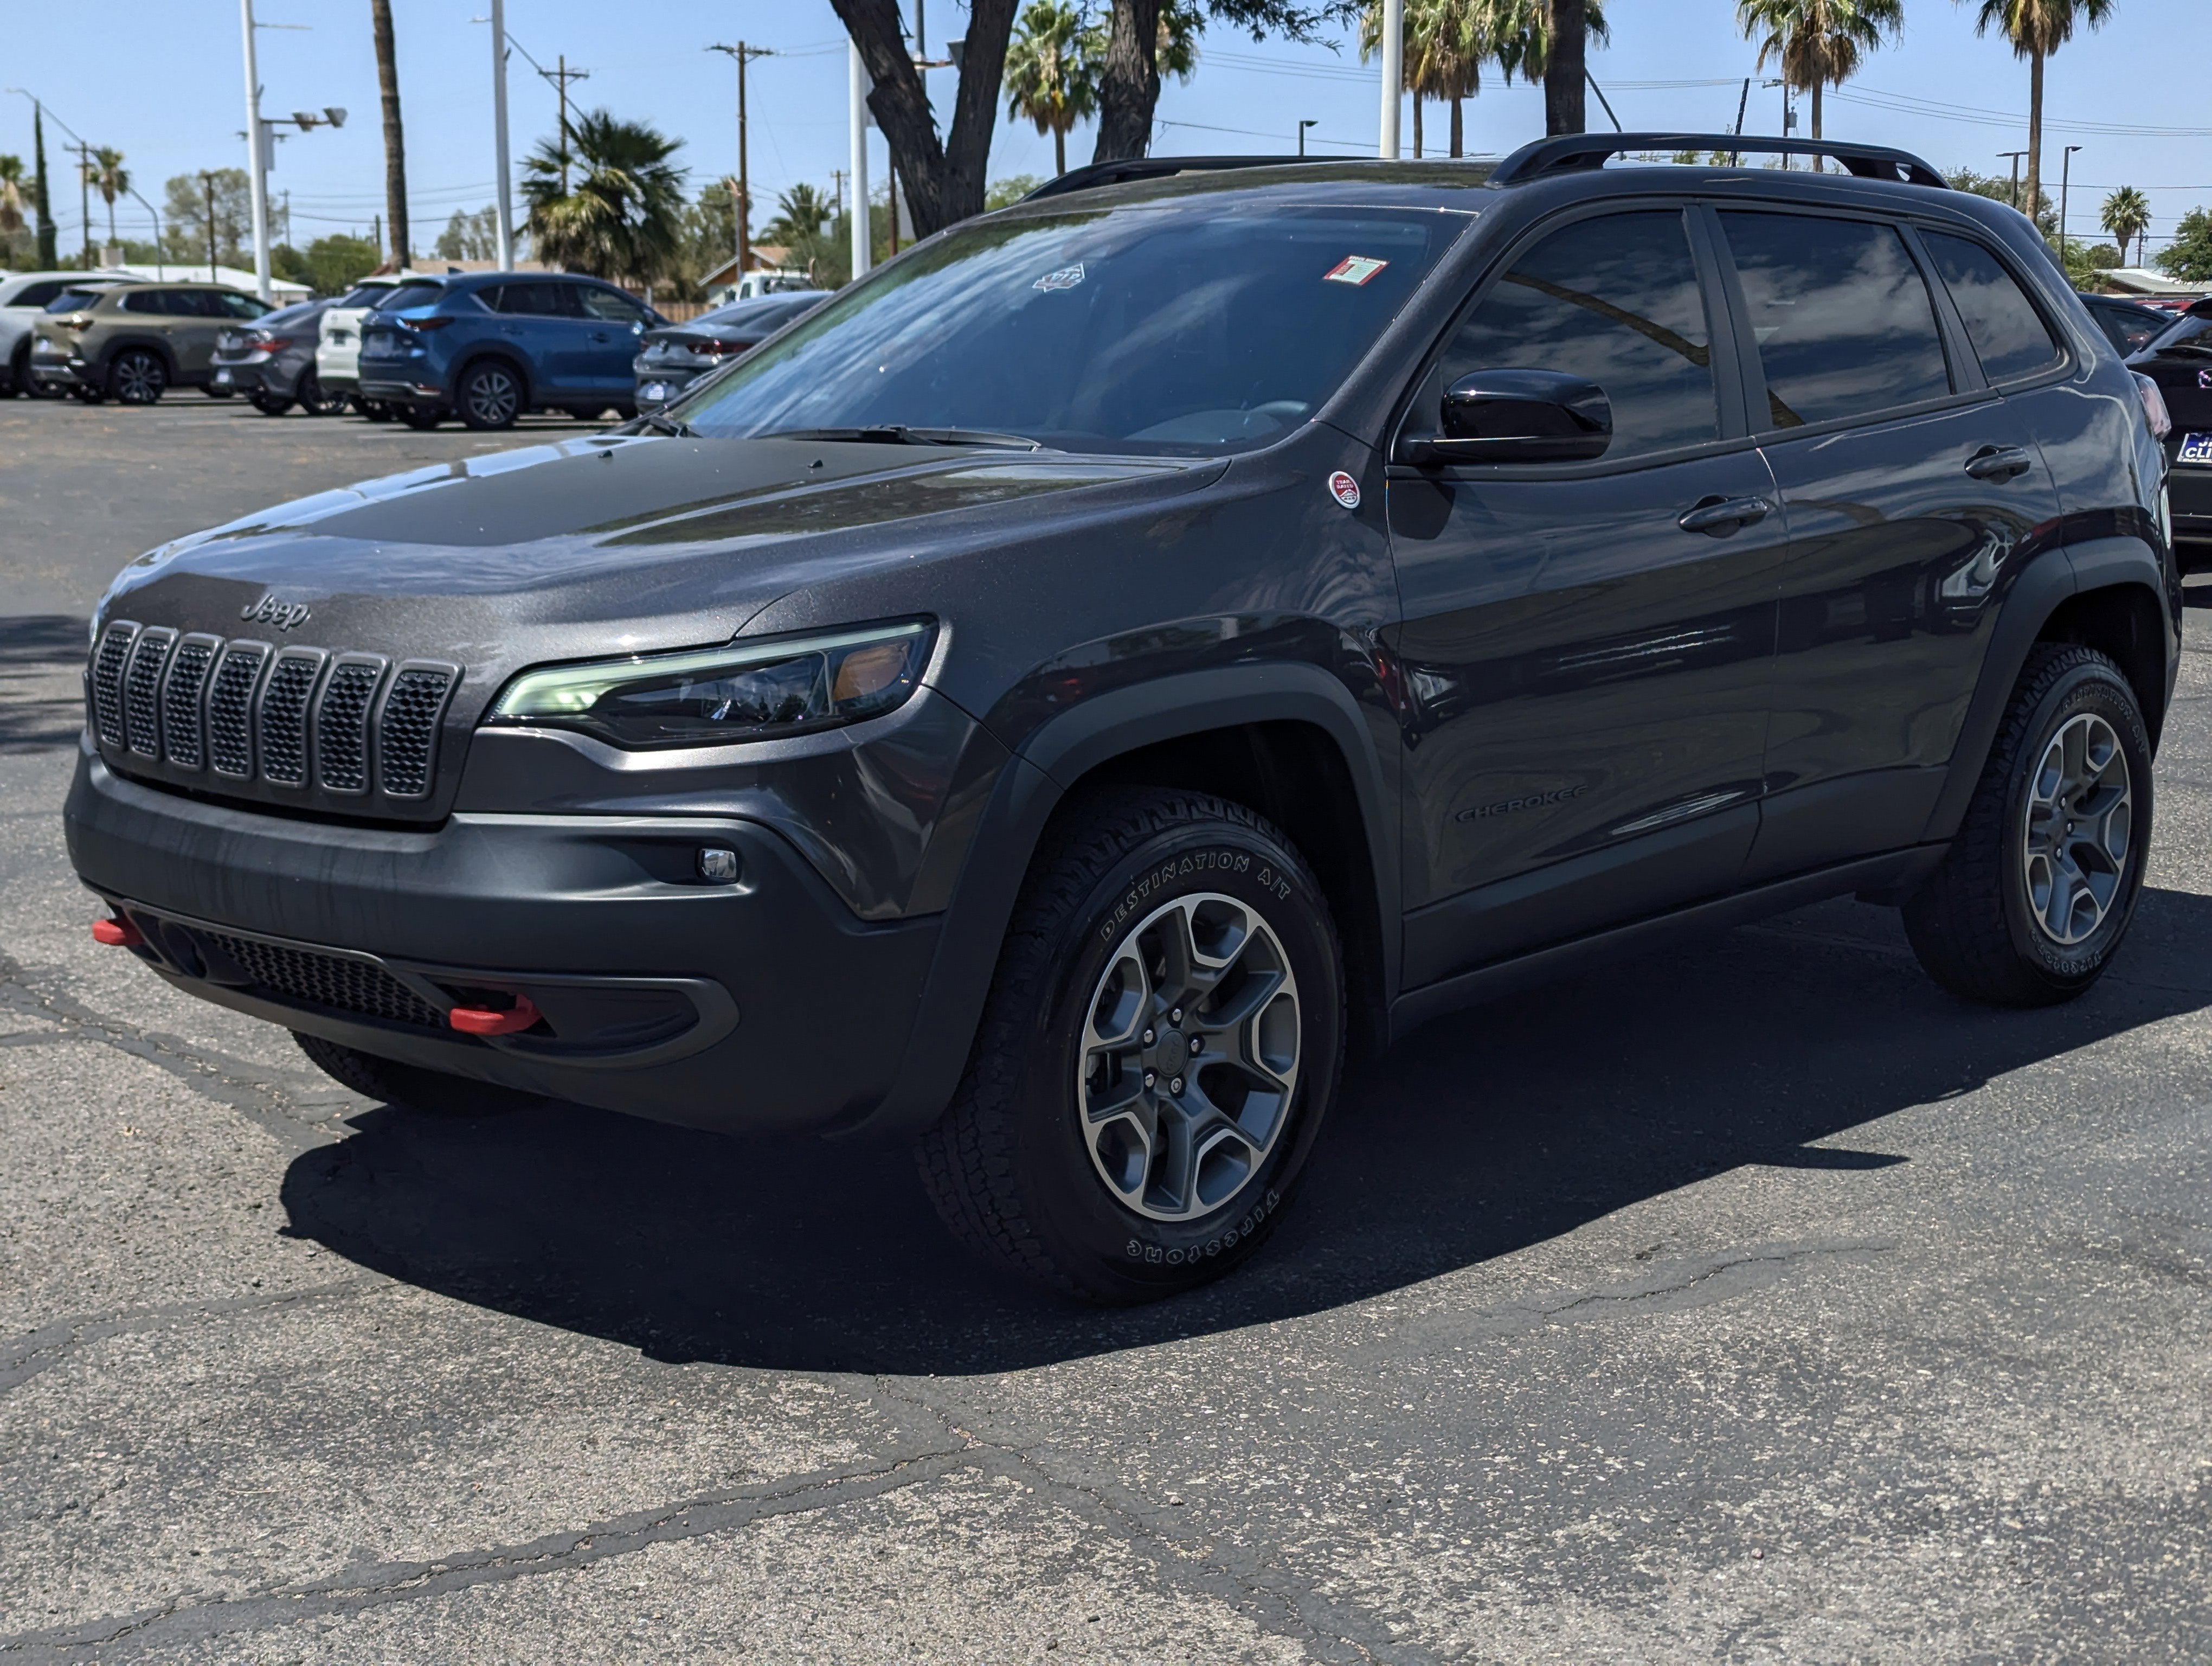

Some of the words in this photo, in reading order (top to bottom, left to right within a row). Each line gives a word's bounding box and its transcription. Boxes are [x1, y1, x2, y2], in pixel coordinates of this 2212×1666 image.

[240, 593, 311, 632] Jeep
[1455, 784, 1589, 822] CHEROKEE
[1100, 852, 1250, 941] DESTINATION
[1257, 867, 1291, 900] A/T
[1126, 1188, 1280, 1265] Firestone
